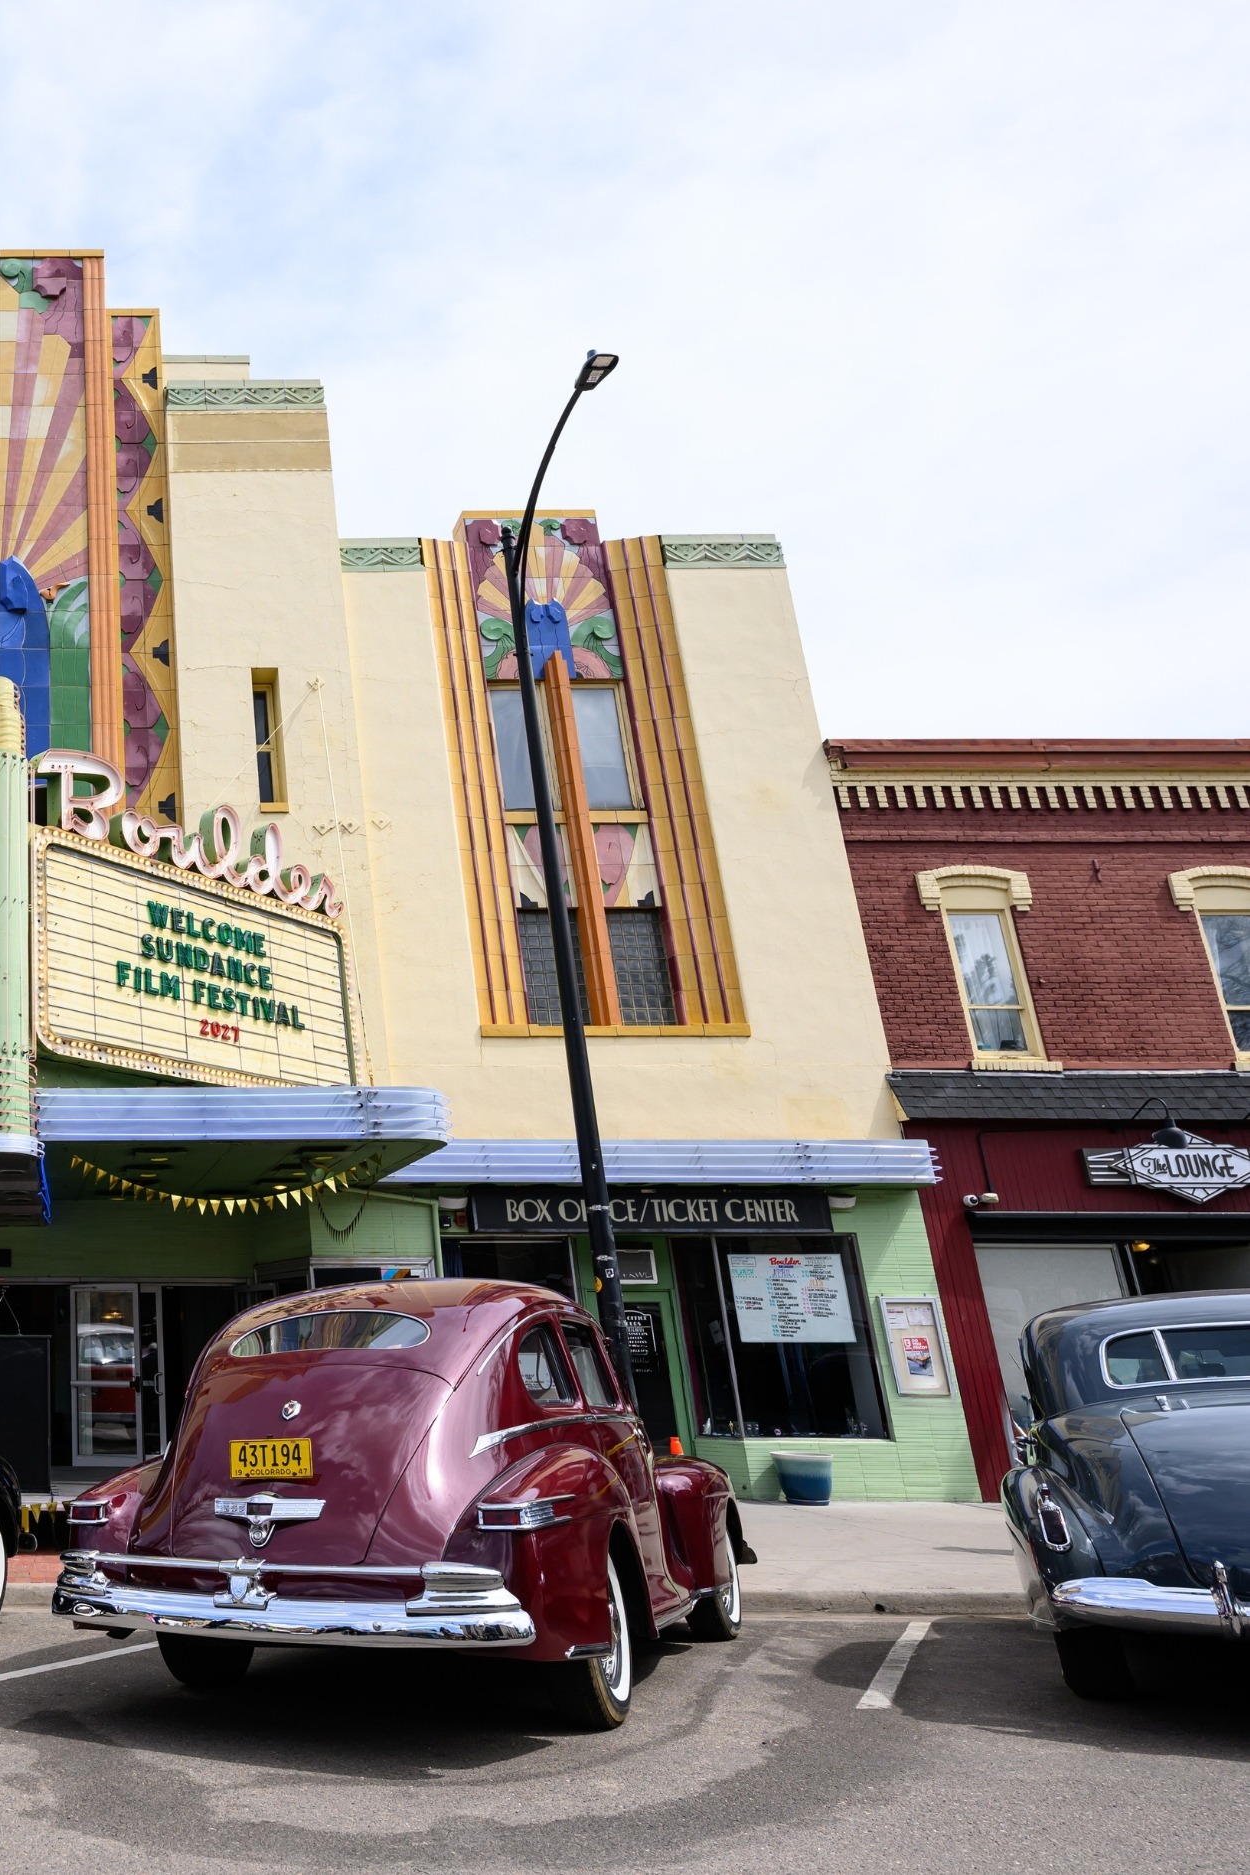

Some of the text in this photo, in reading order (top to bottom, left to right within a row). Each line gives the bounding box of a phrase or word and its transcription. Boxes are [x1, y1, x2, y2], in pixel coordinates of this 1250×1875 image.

[33, 748, 344, 918] Boulder
[147, 900, 266, 957] WELCOME
[141, 933, 273, 990] SUNDANCE
[116, 960, 305, 1030] FILM FESTIVAL
[199, 1018, 240, 1042] 2027
[1140, 1153, 1238, 1178] The LOUNGE
[505, 1199, 553, 1222] BOX
[724, 1199, 800, 1222] CENTER
[769, 1257, 801, 1266] Boulder
[238, 1443, 301, 1468] 43T194
